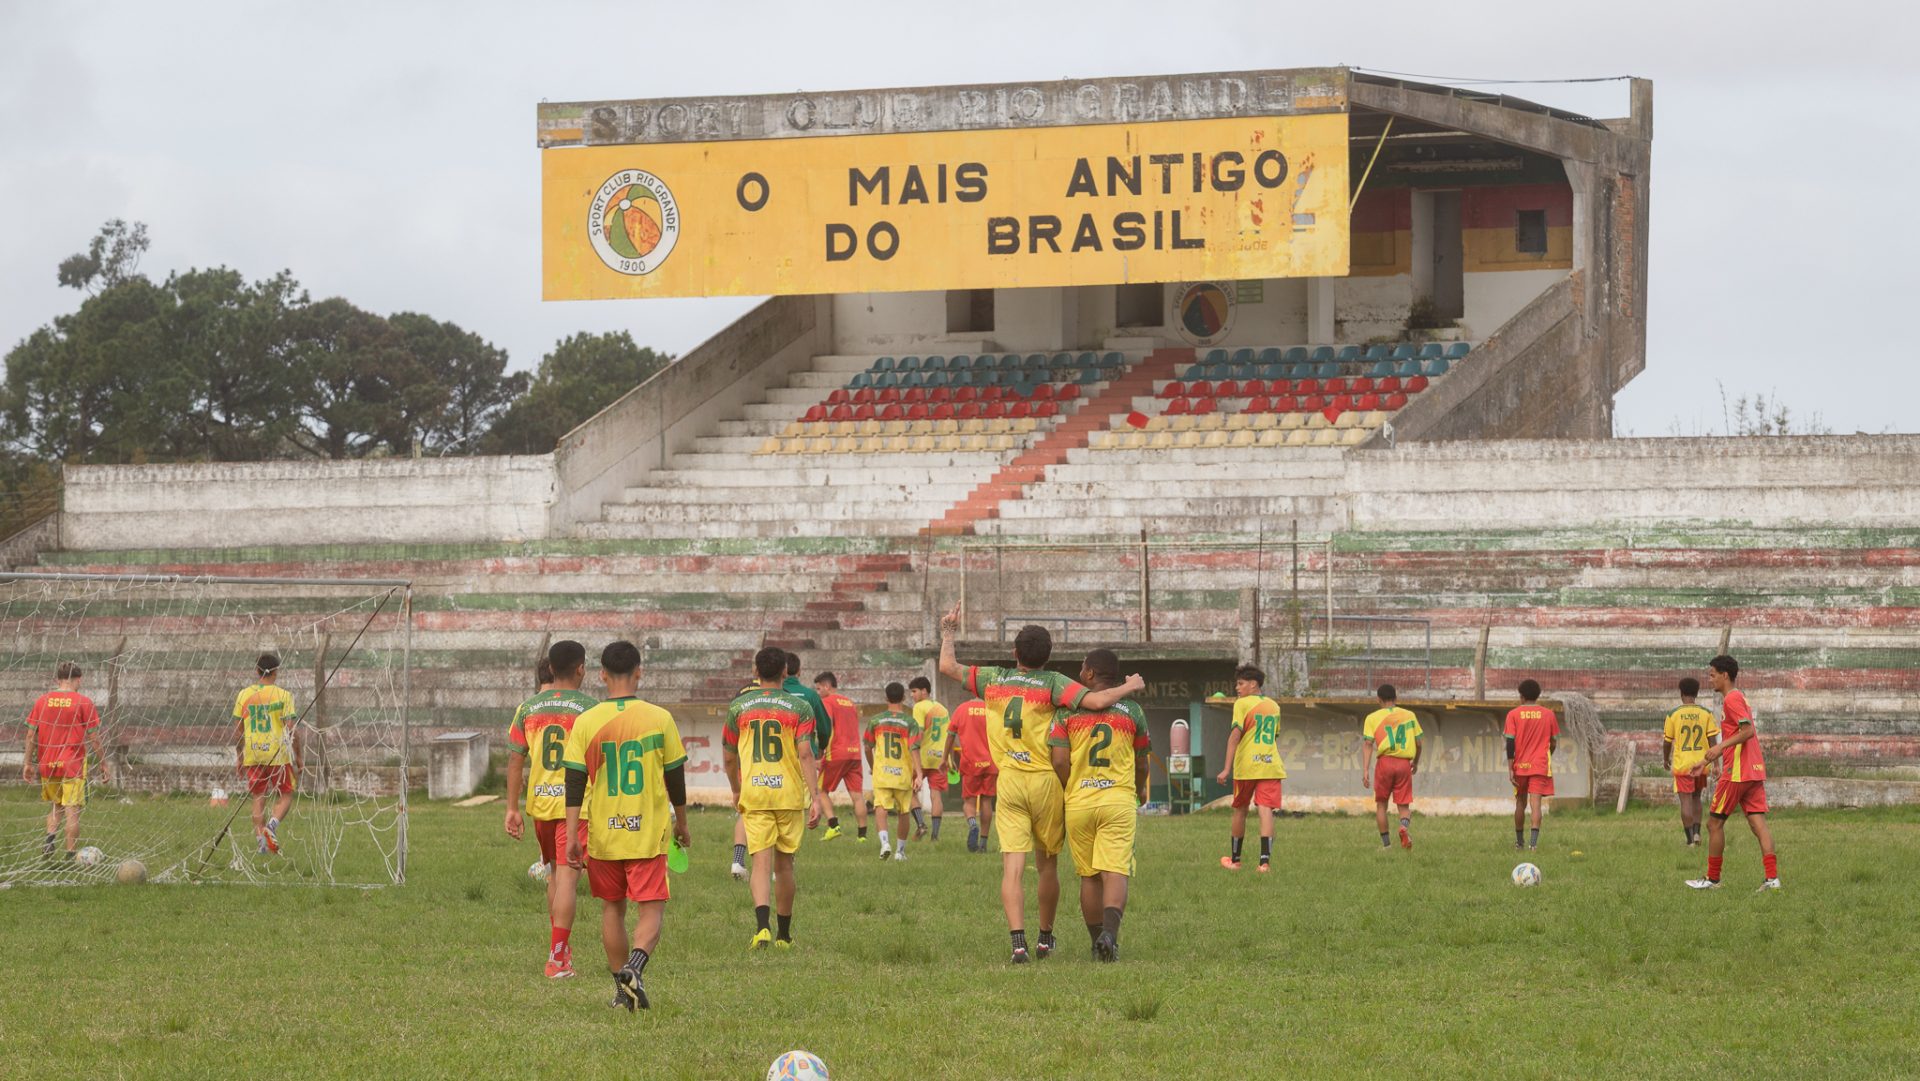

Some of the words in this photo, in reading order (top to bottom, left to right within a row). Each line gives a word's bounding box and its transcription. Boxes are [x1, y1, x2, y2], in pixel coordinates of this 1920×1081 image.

[737, 172, 770, 212] O
[849, 162, 988, 206] MAIS
[1065, 150, 1288, 198] ANTIGO
[592, 195, 605, 236] SPORT
[603, 173, 631, 195] CLUB
[636, 173, 655, 187] RIO
[654, 184, 675, 232] GRANDE
[826, 221, 900, 262] DO
[987, 210, 1205, 255] BRASIL
[620, 260, 645, 271] 1900
[1132, 681, 1190, 698] ANTES
[248, 704, 271, 733] 15
[932, 717, 942, 742] 5
[1003, 696, 1024, 739] 4
[1254, 714, 1275, 745] 19
[541, 724, 565, 771] 6
[750, 719, 784, 763] 16
[883, 732, 902, 760] 15
[1089, 723, 1113, 768] 2
[1384, 723, 1406, 750] 14
[1681, 725, 1703, 751] 22
[601, 740, 645, 796] 16
[608, 815, 641, 830] FLASH
